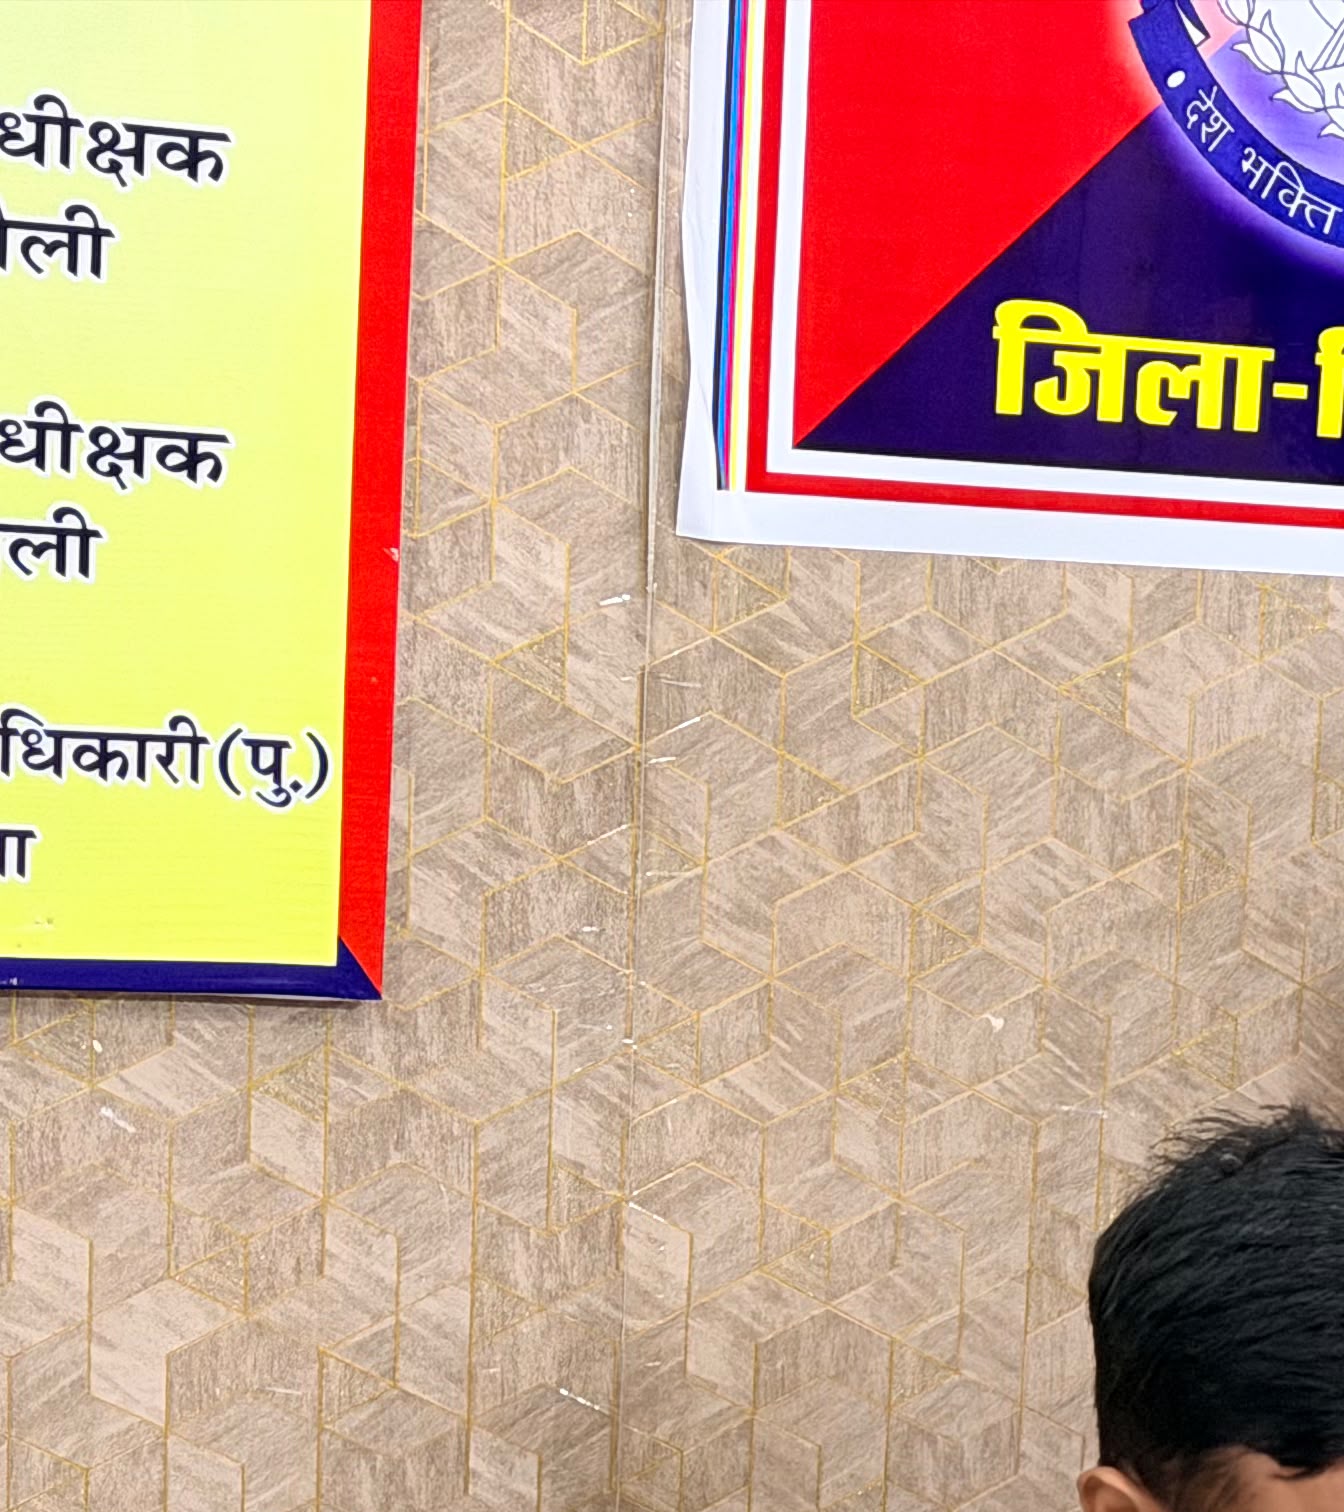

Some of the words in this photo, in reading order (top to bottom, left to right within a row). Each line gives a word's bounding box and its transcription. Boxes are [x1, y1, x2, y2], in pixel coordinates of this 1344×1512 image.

[1186, 87, 1235, 152] देश
[1241, 145, 1344, 236] भक्ति
[0, 203, 116, 280] ली
